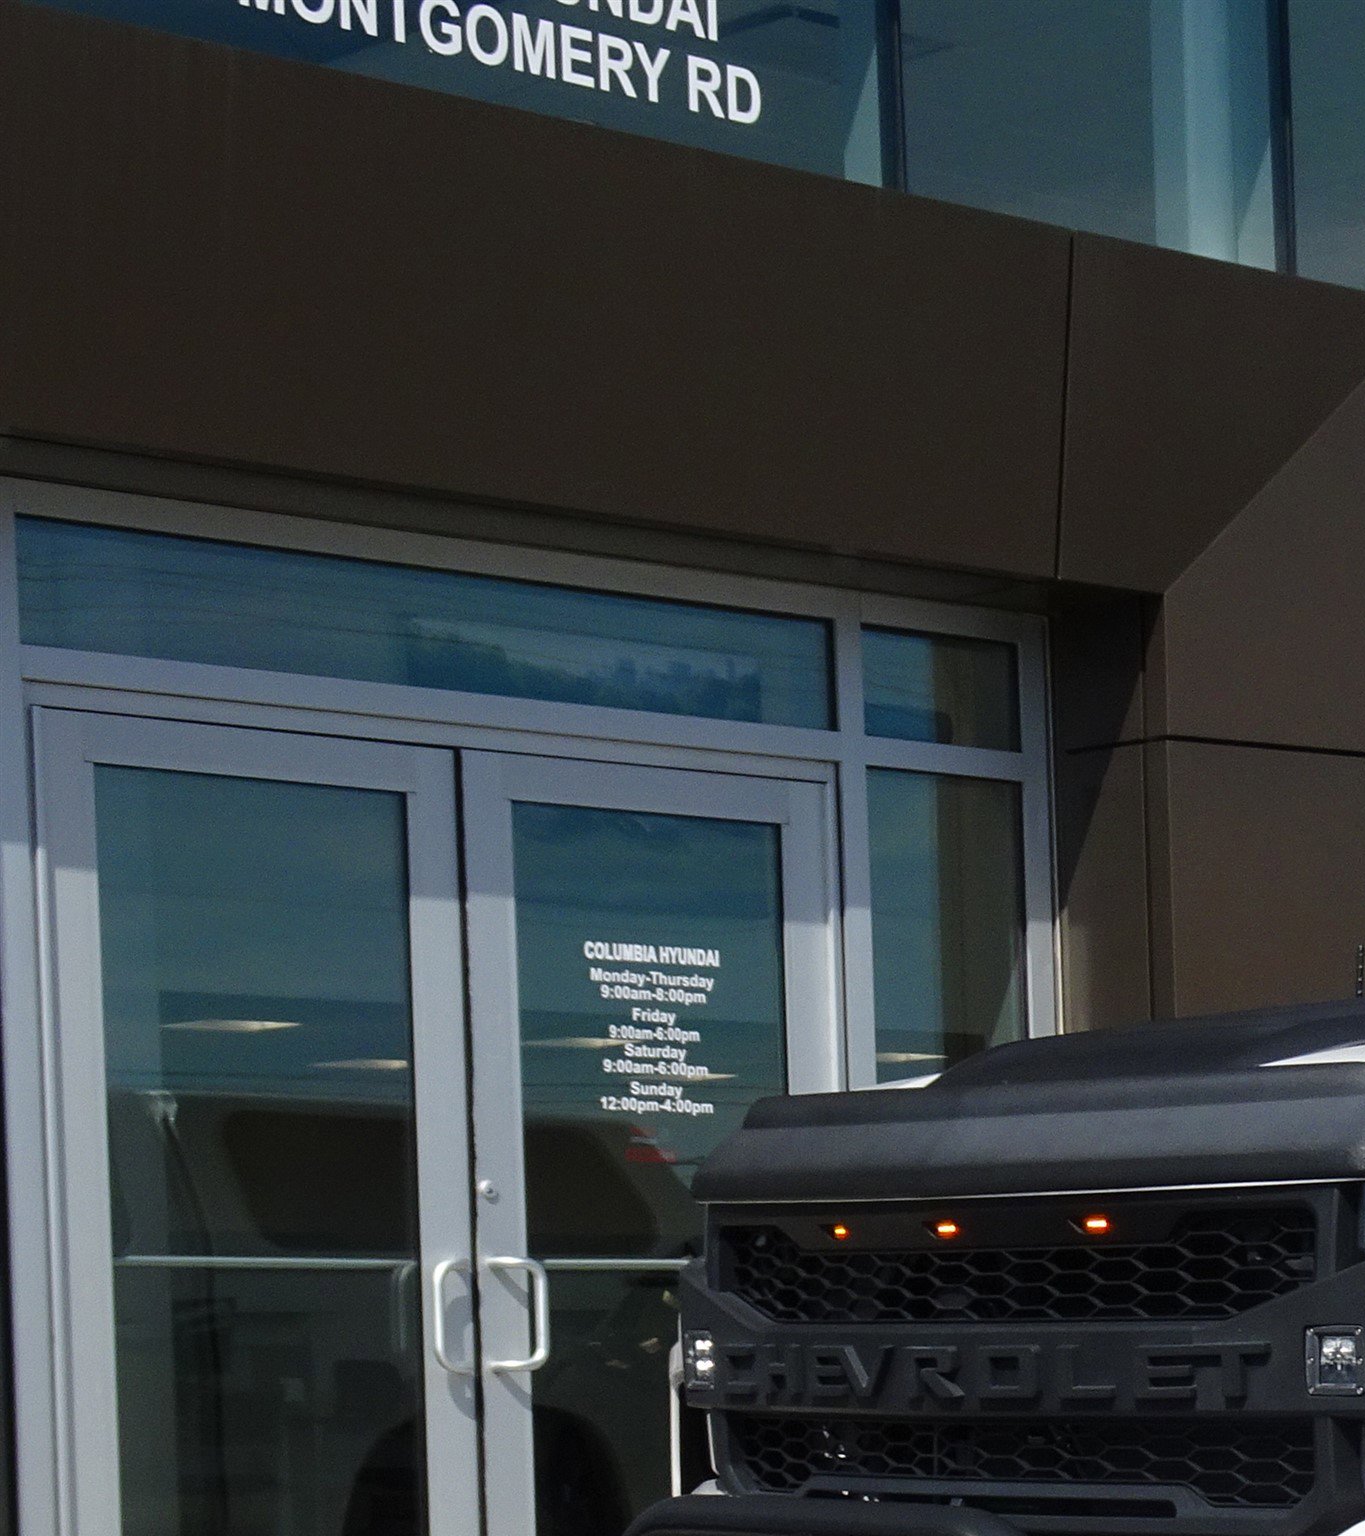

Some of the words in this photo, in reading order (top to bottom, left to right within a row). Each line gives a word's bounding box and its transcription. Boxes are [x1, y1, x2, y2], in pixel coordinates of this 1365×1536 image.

[687, 53, 761, 125] RD
[583, 940, 658, 964] COLUMBIA
[659, 946, 720, 968] HYUNDAI
[590, 967, 714, 992] Monday-Thursday
[600, 984, 707, 1006] 9:00am-8:00pm
[632, 1007, 676, 1026] Friday
[609, 1025, 700, 1043] 9:00am-6:00pm
[624, 1043, 687, 1062] Saturday
[602, 1058, 708, 1079] 9:00am-6:00pm
[630, 1080, 683, 1100] Sunday
[600, 1096, 714, 1116] 12:00pm-4:00pm
[718, 1340, 1272, 1405] CHEVROLET
